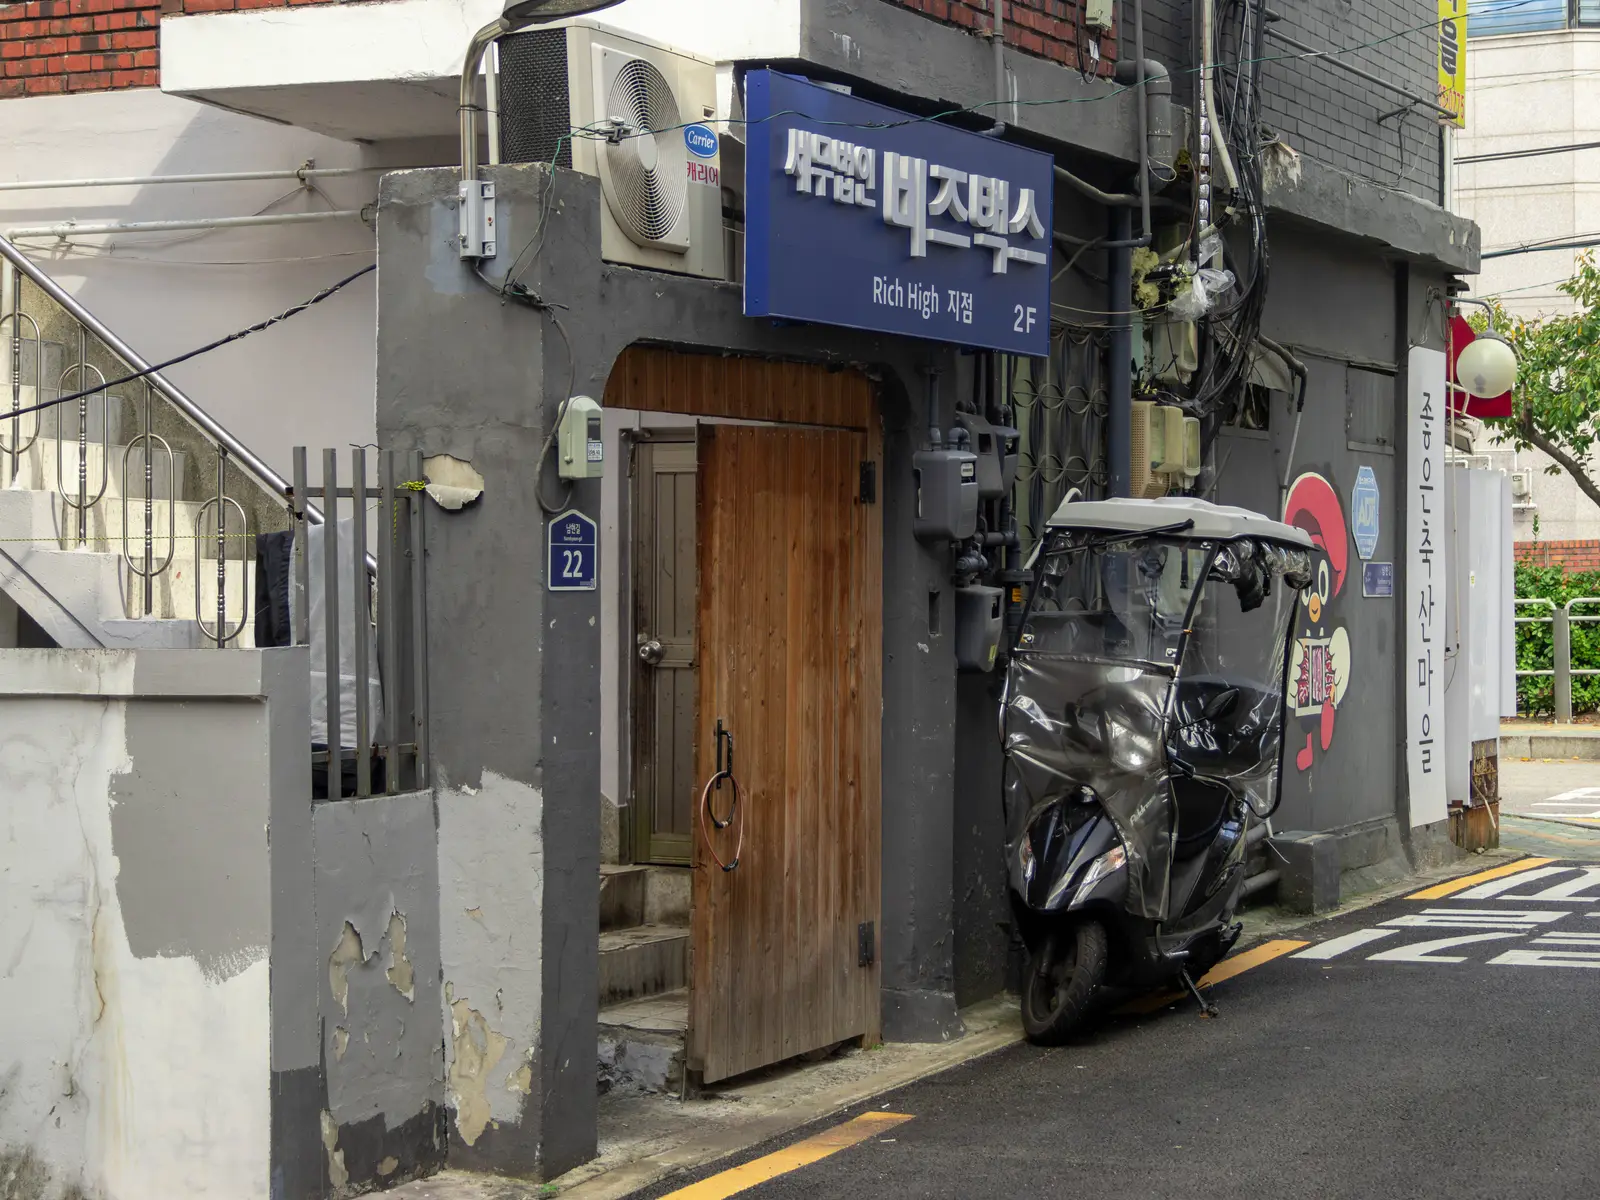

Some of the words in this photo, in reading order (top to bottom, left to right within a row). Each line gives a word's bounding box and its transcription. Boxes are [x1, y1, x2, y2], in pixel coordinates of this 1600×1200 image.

[687, 130, 715, 149] Carrier
[687, 161, 719, 187] 캐리어
[785, 128, 876, 207] 세무법인
[883, 151, 1047, 274] 비즈택스
[873, 276, 904, 308] Rich
[908, 282, 939, 320] High
[947, 289, 973, 325] 지점
[1013, 303, 1037, 334] 2F
[562, 550, 583, 578] 22
